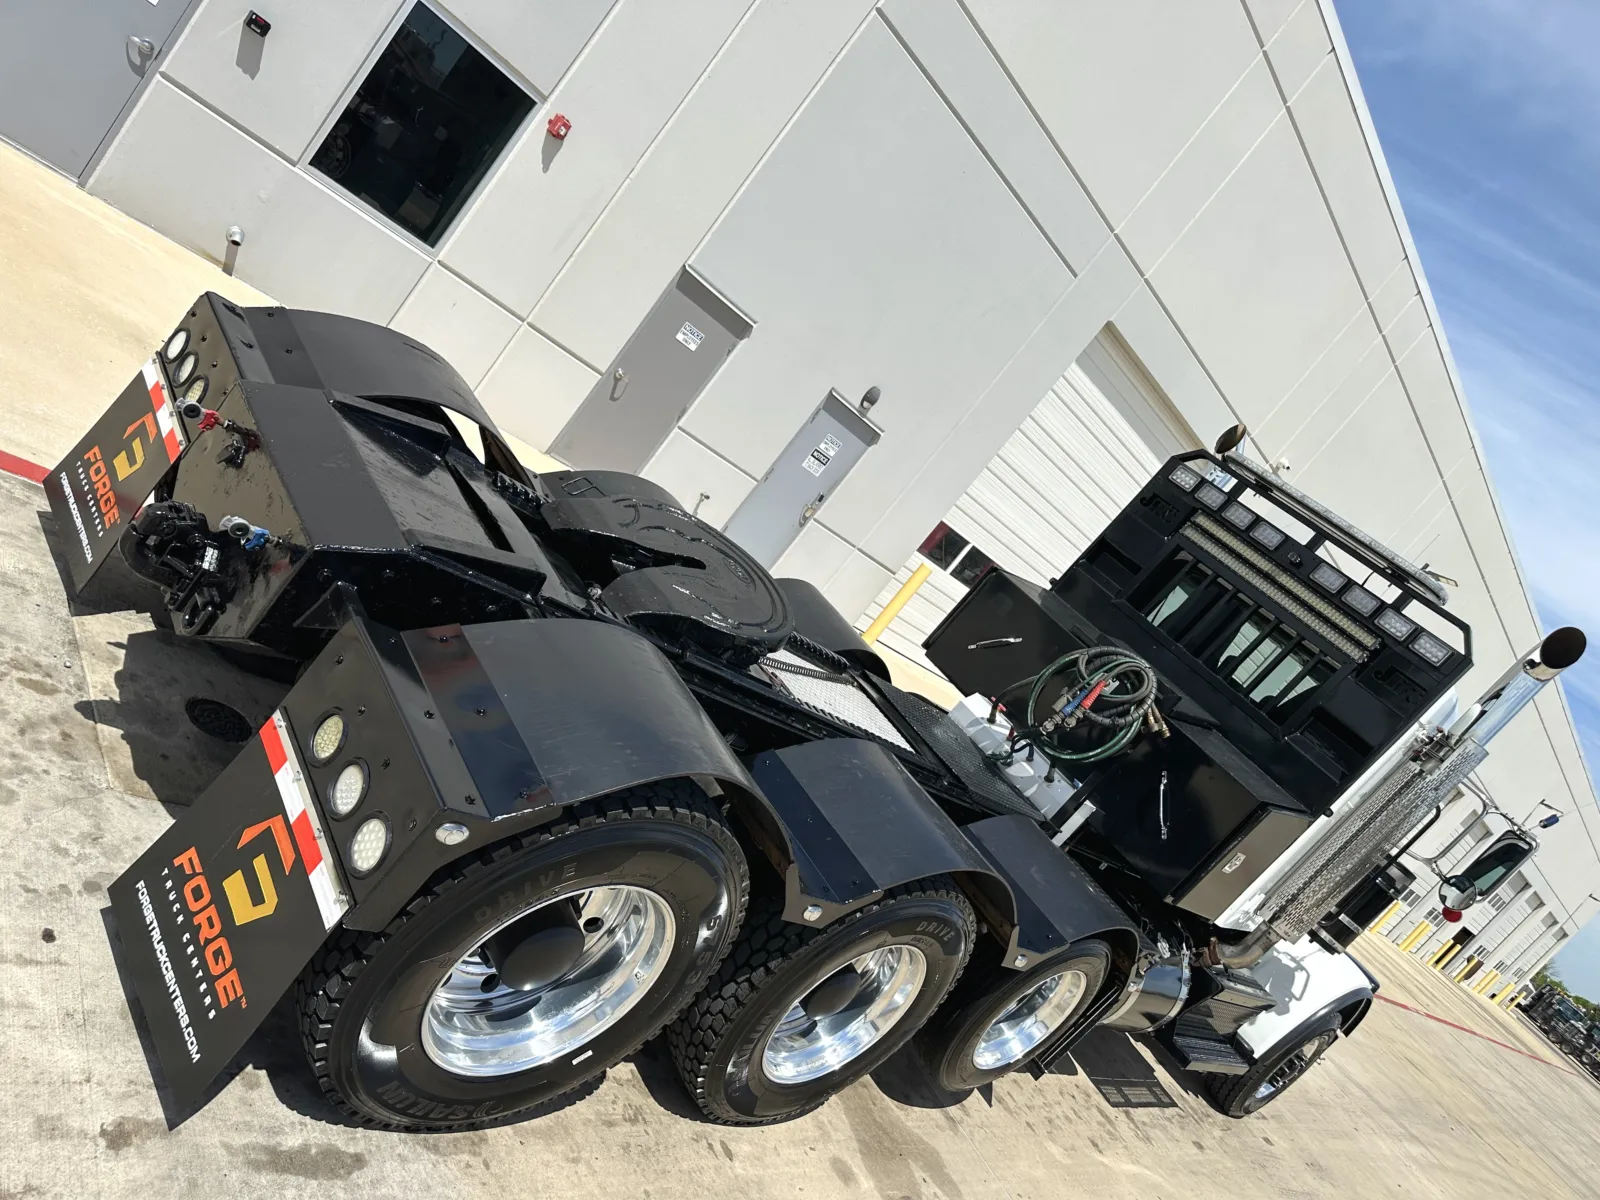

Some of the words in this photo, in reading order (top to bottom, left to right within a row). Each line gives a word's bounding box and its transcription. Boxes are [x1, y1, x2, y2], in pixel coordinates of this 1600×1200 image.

[683, 324, 703, 341] NOTICE
[84, 445, 120, 529] FORGE
[812, 451, 829, 465] NOTICE
[59, 471, 93, 564] FORGETRUCKCENTERS.COM
[76, 461, 90, 492] TRUCK
[87, 494, 104, 538] CENTERS
[173, 846, 244, 1009] FORGE
[474, 863, 577, 922] DRIVE
[161, 867, 184, 925] TRUCK
[182, 932, 216, 1020] CENTERS
[916, 921, 955, 942] DRIVE
[135, 879, 201, 1064] FORGETRUCKCENTERS.COM
[376, 1080, 475, 1119] SAILUN
